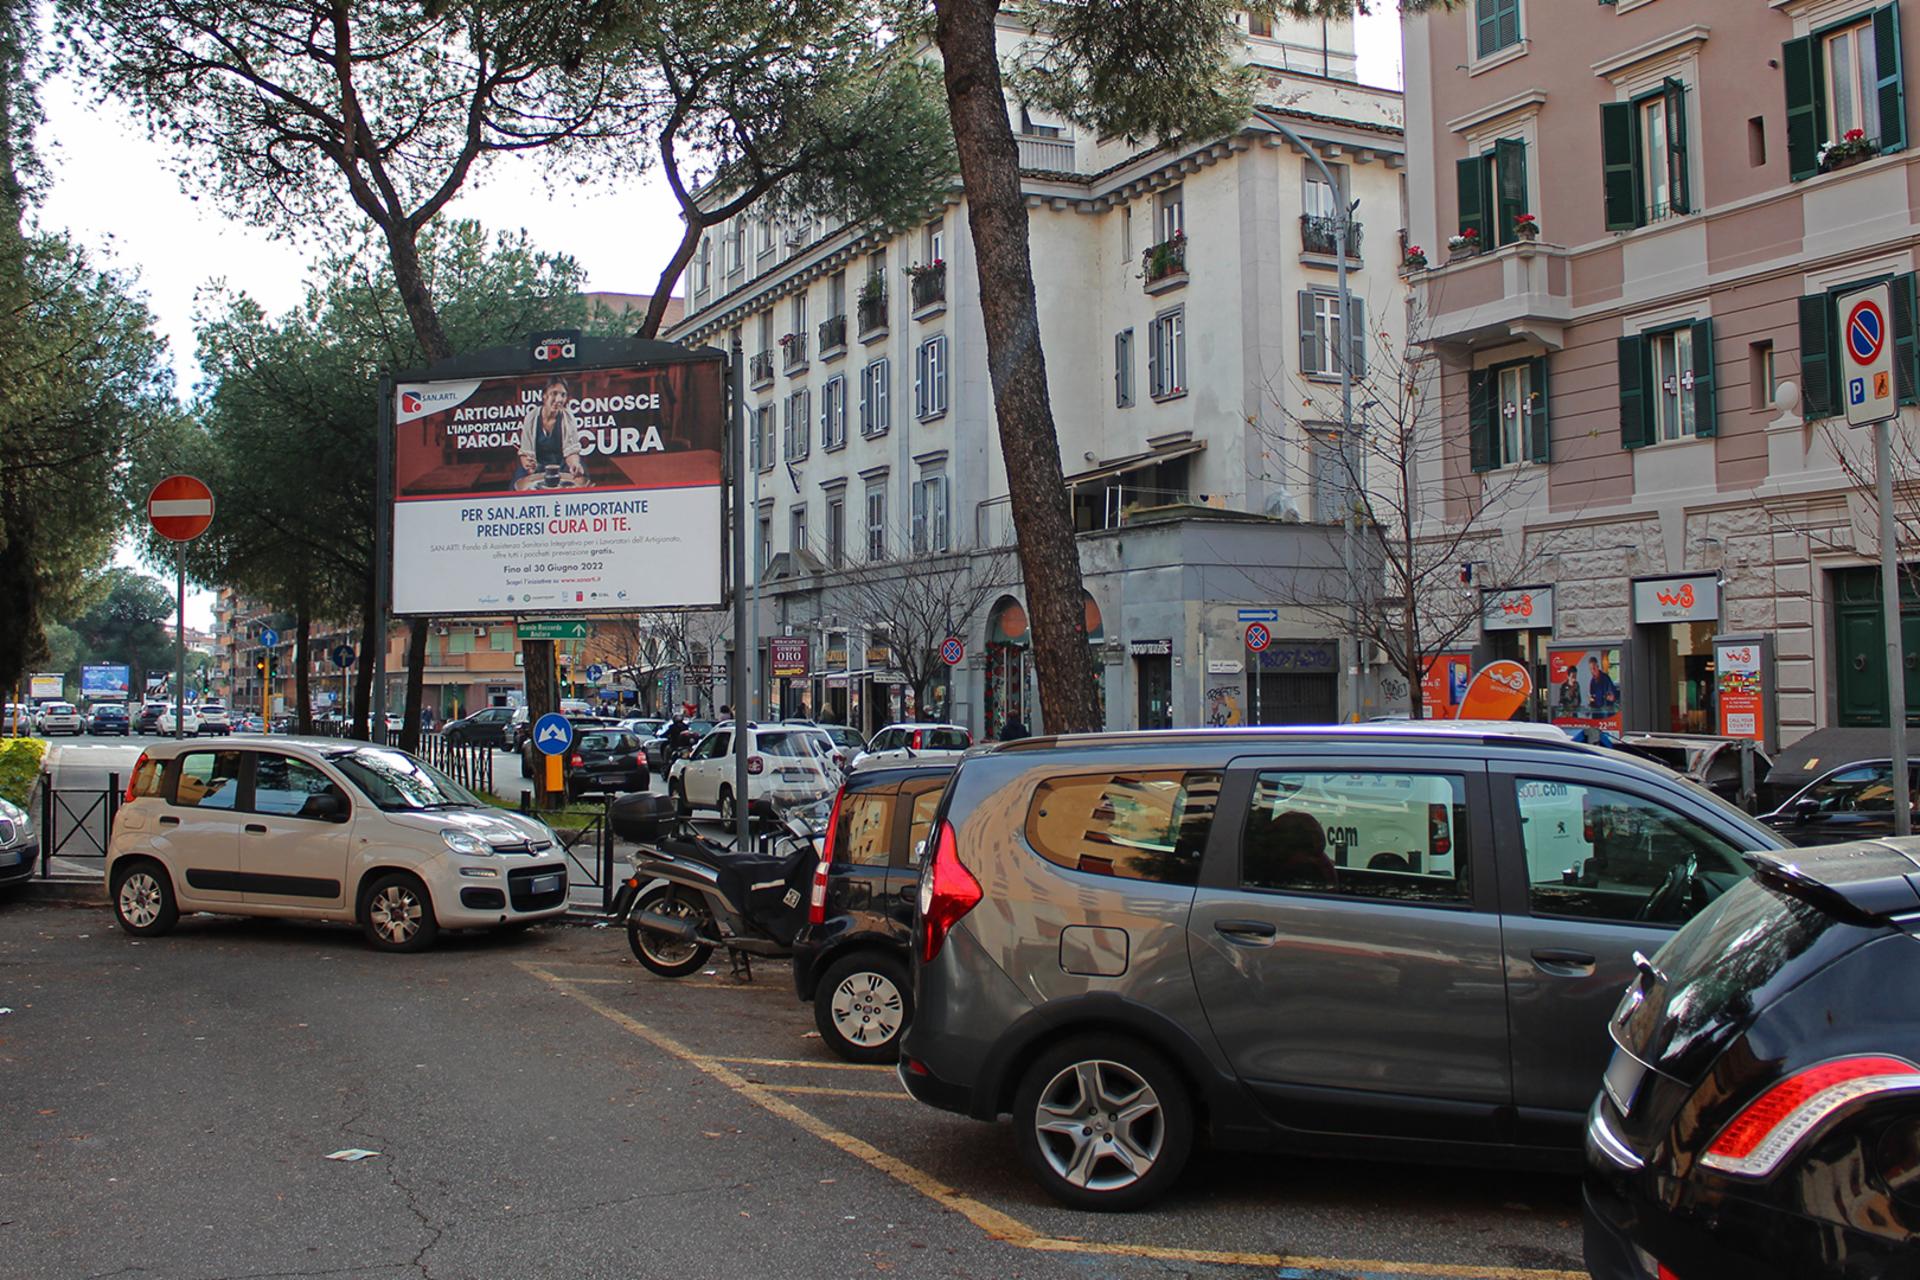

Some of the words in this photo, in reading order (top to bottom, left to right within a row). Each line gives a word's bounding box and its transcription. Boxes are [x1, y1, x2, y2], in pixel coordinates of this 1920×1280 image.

[534, 344, 576, 362] apa
[521, 390, 543, 403] UN
[568, 393, 660, 414] CONOSCE
[446, 421, 524, 435] L'IMPORTANZA
[576, 415, 617, 428] DELLA
[457, 432, 521, 449] PAROLA
[578, 426, 665, 456] CURA
[461, 509, 483, 521] PER
[487, 505, 549, 521] SAN.ARTI.
[554, 501, 561, 517] È
[565, 500, 648, 517] IMPORTANTE
[476, 522, 545, 538] PRENDERSI
[548, 518, 588, 535] CURA
[593, 518, 607, 532] DI
[612, 517, 632, 531] TE.
[504, 564, 521, 574] Fino
[523, 564, 532, 573] al
[534, 563, 545, 572] 30
[547, 562, 579, 573] Giugno
[581, 562, 604, 571] 2022
[776, 652, 802, 661] ORO
